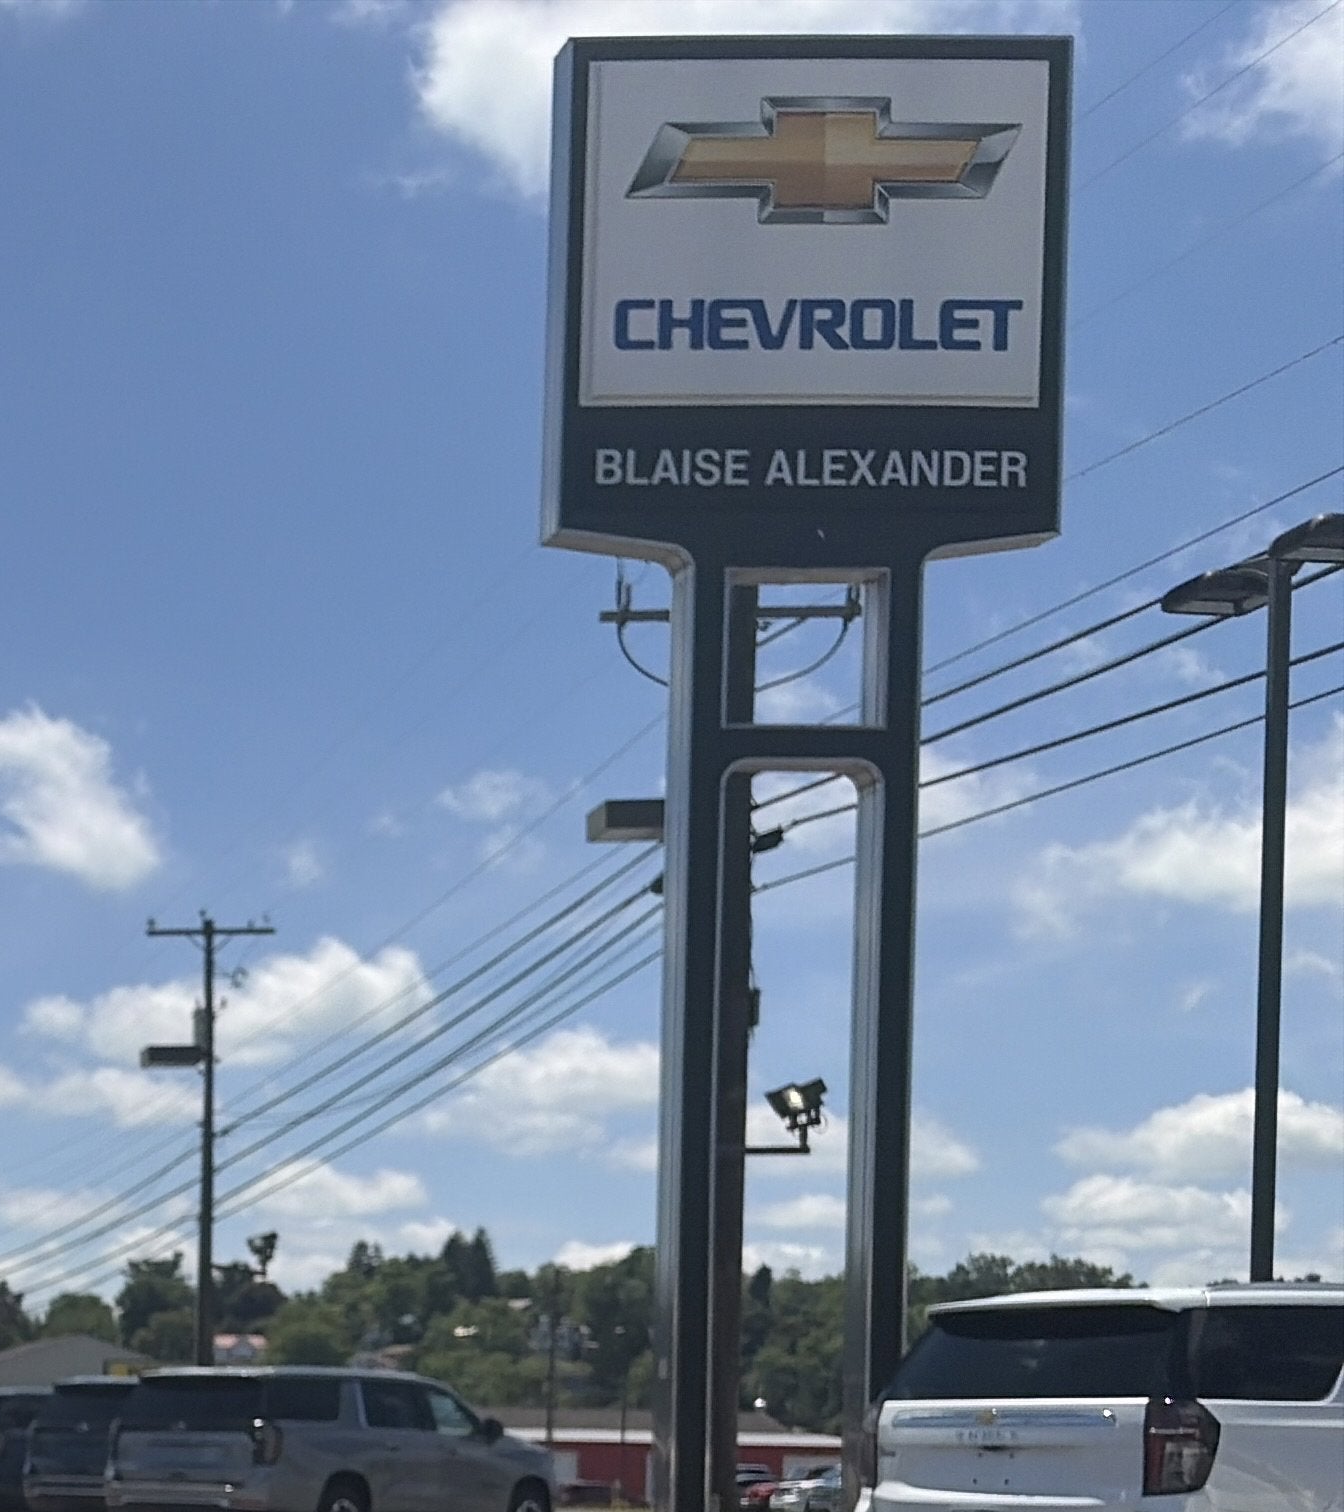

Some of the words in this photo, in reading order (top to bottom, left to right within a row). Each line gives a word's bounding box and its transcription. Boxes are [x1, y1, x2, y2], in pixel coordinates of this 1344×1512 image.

[613, 298, 1023, 352] CHEVROLET
[594, 448, 750, 487] BLAISE
[764, 449, 1028, 488] ALEXANDER
